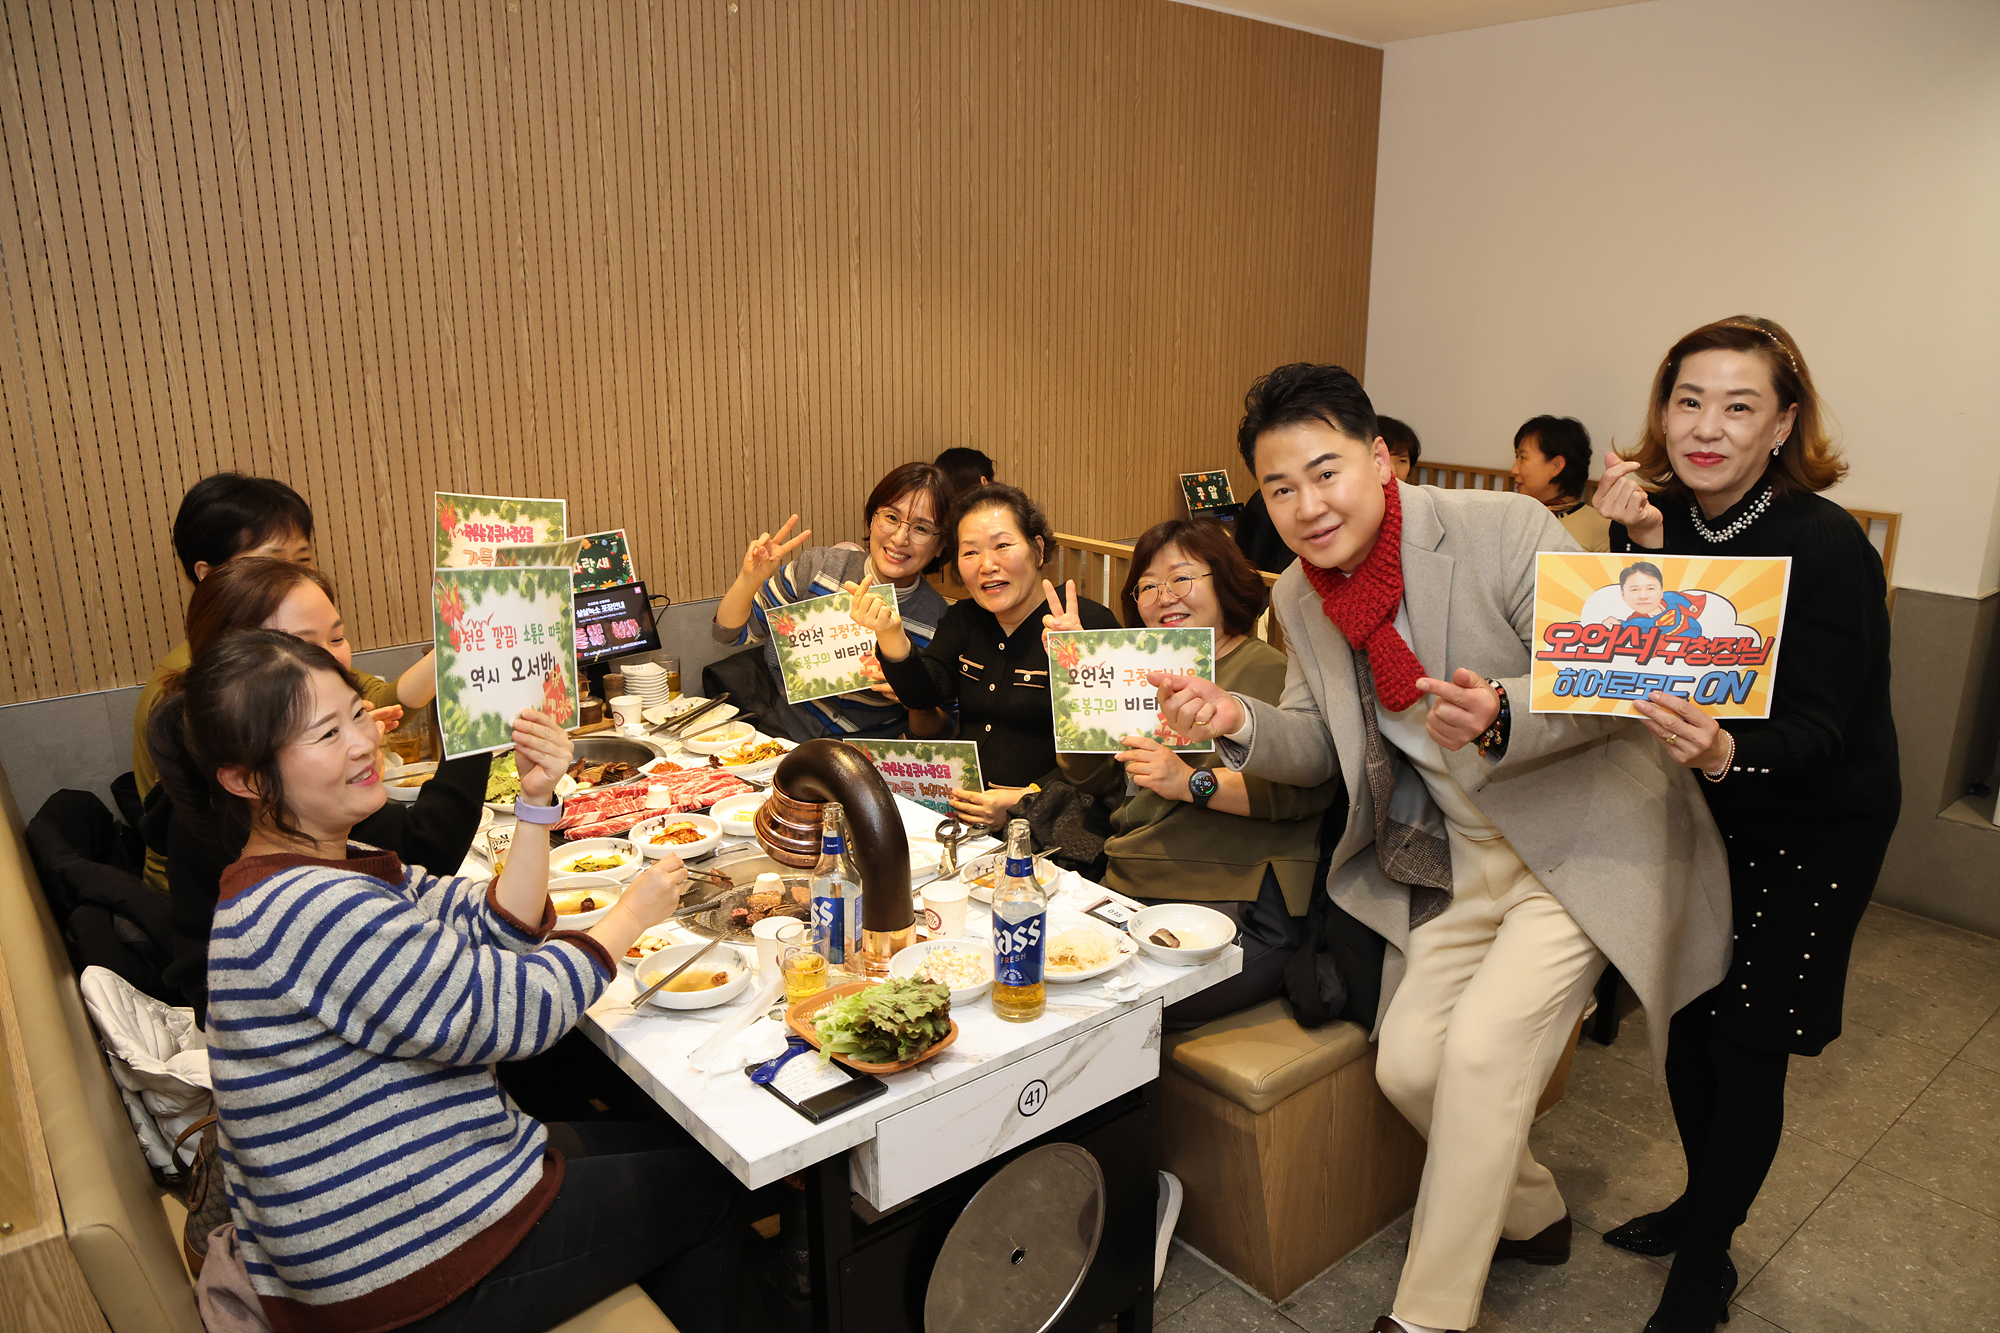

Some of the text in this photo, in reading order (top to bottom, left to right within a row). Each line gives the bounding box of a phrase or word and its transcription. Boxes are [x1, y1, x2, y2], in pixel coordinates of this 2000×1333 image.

[463, 547, 494, 567] 가득
[449, 628, 485, 653] 행정은
[492, 625, 518, 649] 깔끔!
[523, 623, 545, 645] 소통은
[789, 627, 824, 648] 오언석
[1535, 622, 1776, 667] 오언석 구청장님
[794, 639, 873, 670] 도봉구의 비타민
[470, 651, 556, 692] 역시 오서방!
[1068, 666, 1115, 688] 오언석
[1553, 667, 1759, 705] 히어로모드 ON
[1070, 696, 1159, 716] 도봉구의 비타
[1000, 952, 1027, 964] FRESH
[1024, 1087, 1041, 1107] 41
